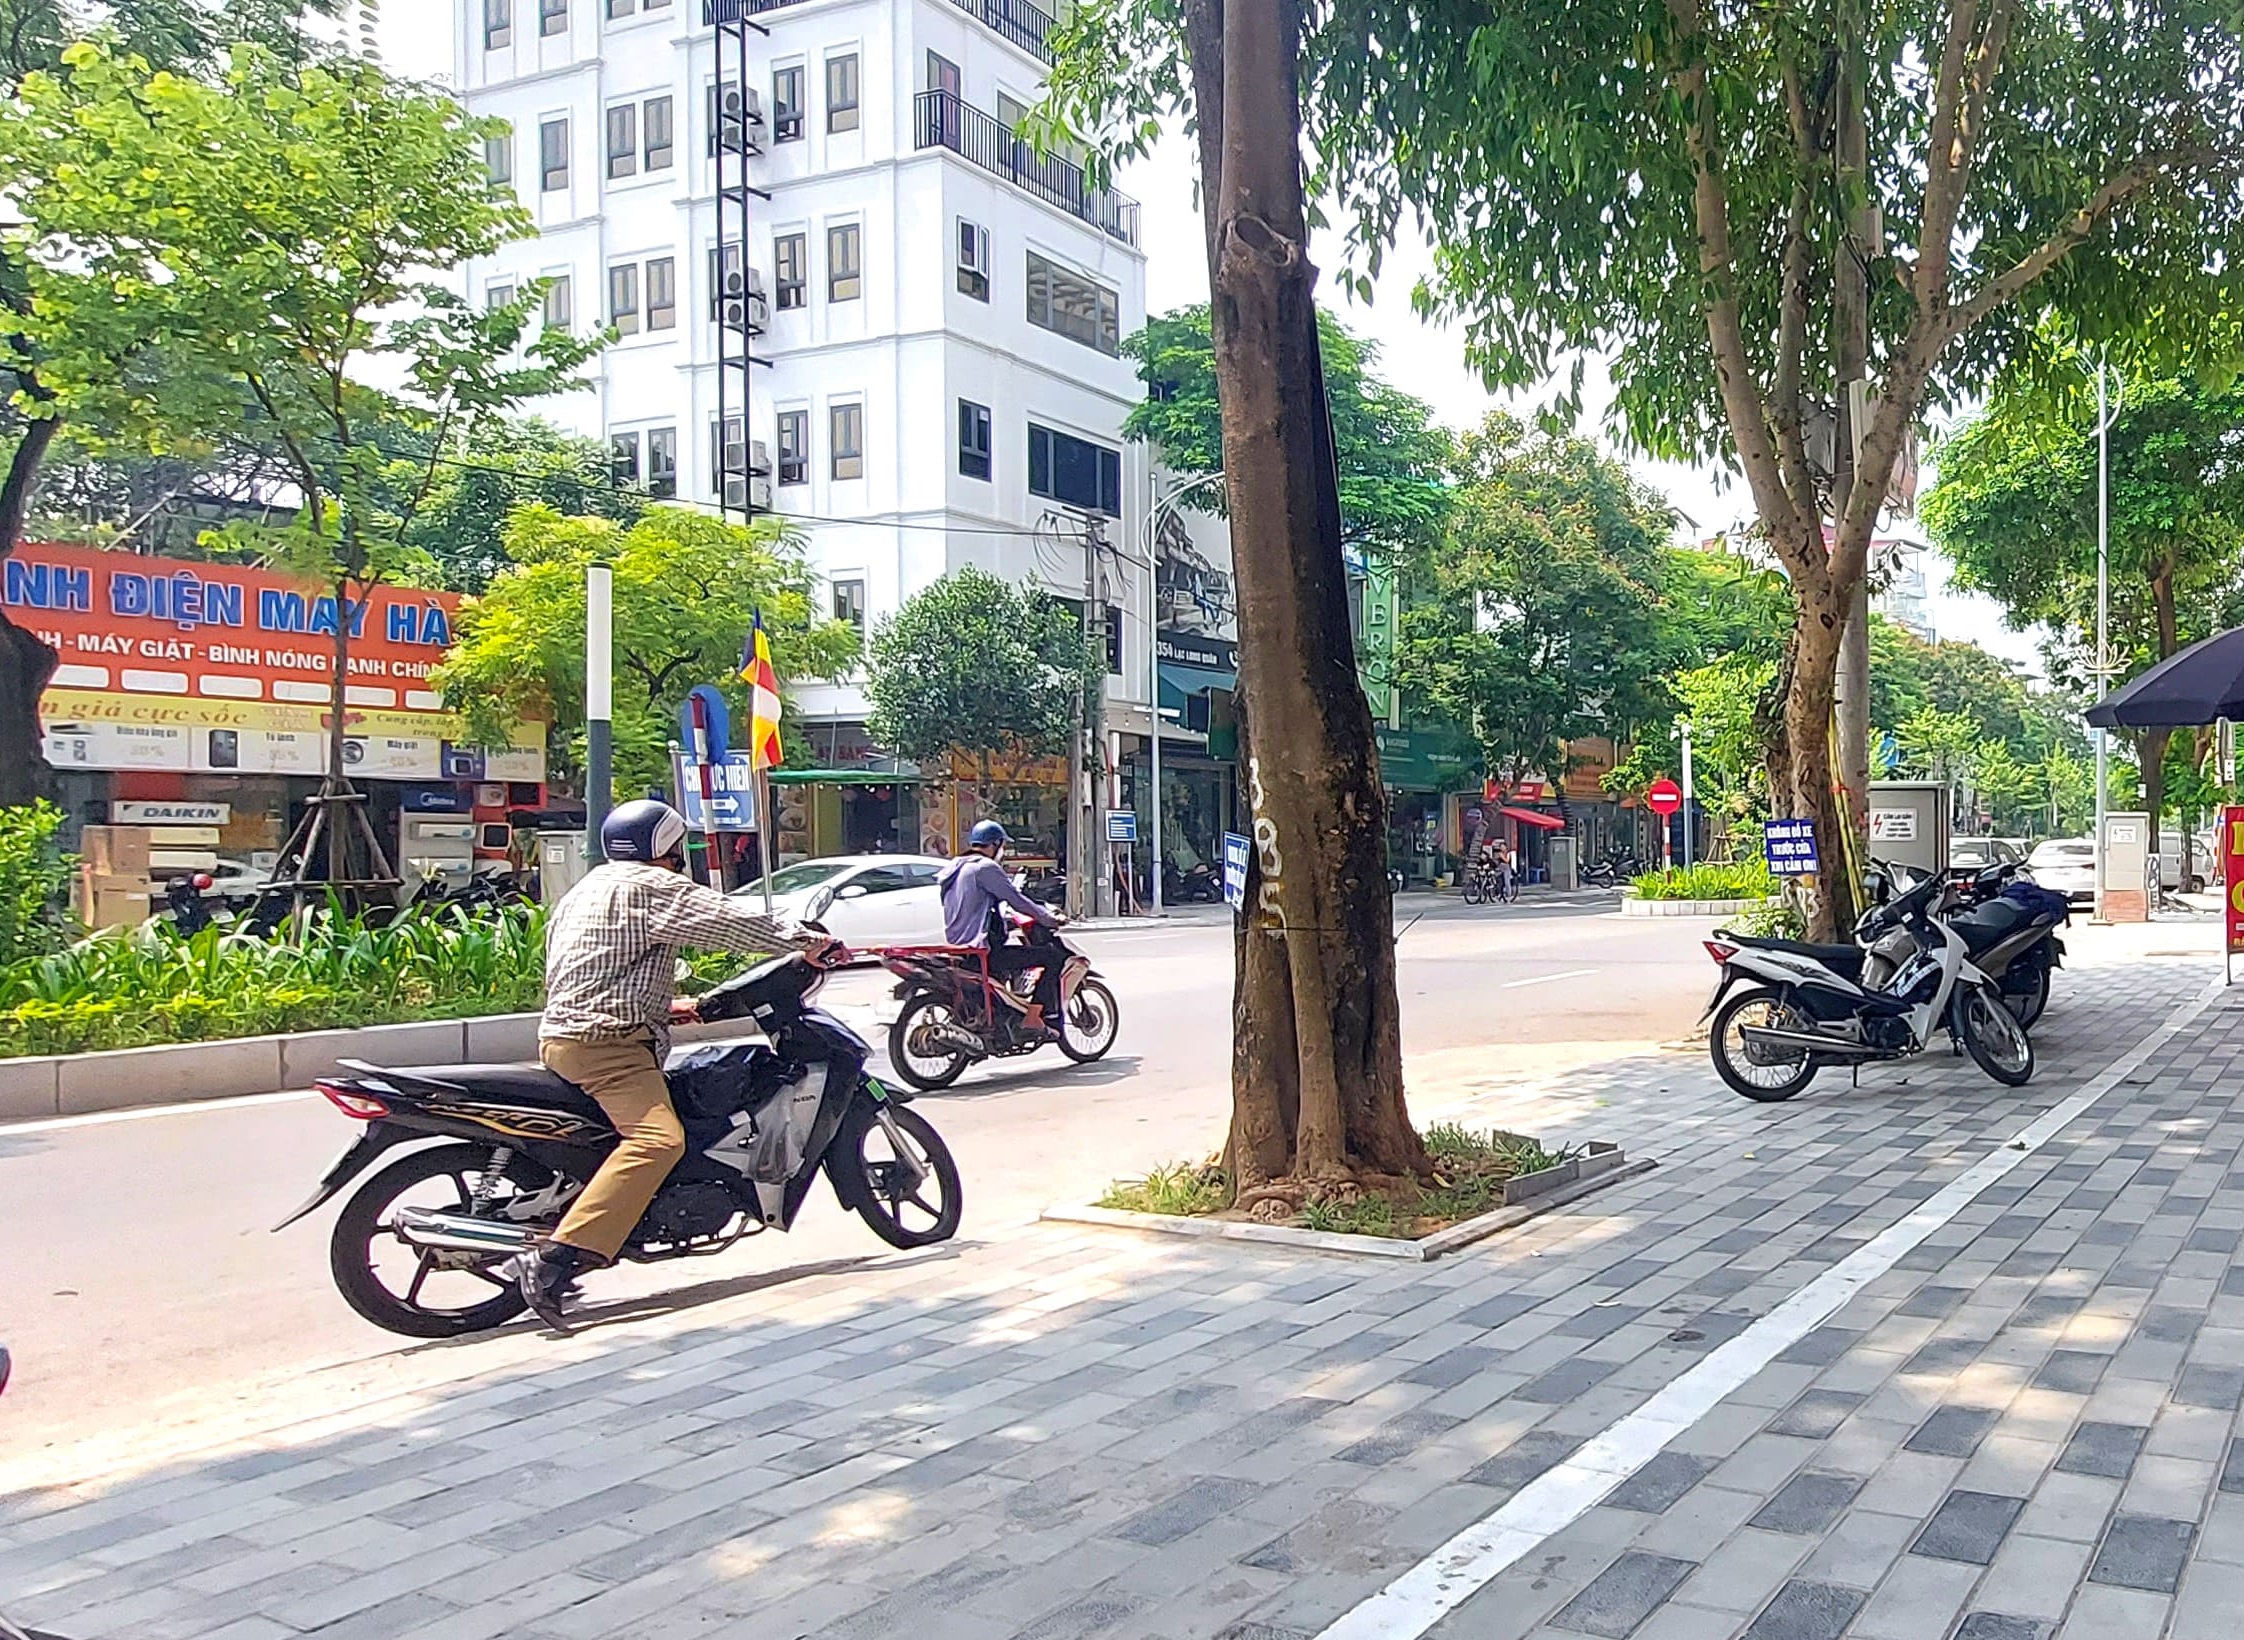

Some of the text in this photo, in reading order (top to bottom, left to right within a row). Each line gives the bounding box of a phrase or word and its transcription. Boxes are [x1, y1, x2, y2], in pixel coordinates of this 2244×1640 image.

[3, 558, 94, 613] NH
[109, 569, 245, 631] ĐIỆN
[387, 597, 453, 647] HÀ
[78, 633, 134, 657] MÁY
[140, 638, 196, 661] GIẶT
[209, 642, 259, 665] BÌNH
[266, 651, 327, 671] NÓNG
[391, 659, 438, 679] CHÍN
[70, 700, 121, 720] giá
[132, 706, 189, 724] cực
[200, 704, 248, 724] sốc
[142, 806, 220, 819] DAIKIN
